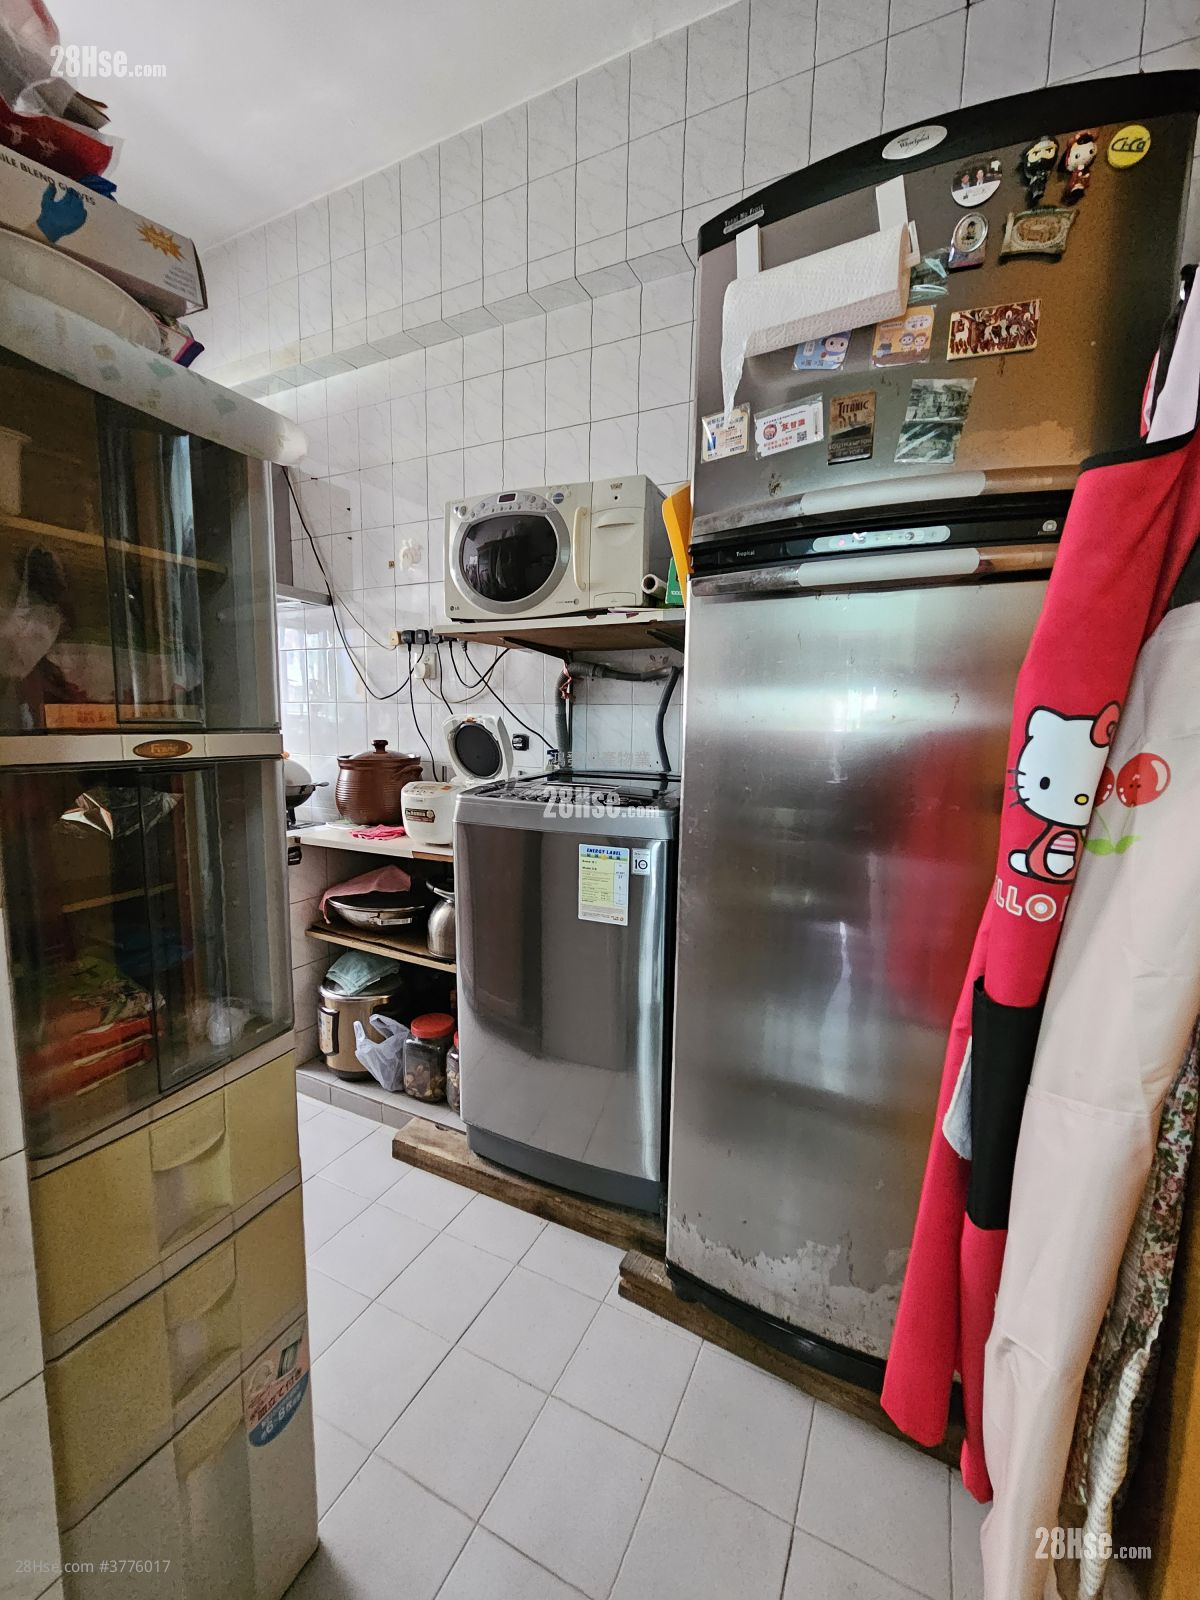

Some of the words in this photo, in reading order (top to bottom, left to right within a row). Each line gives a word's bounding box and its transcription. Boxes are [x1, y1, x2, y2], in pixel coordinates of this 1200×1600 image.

[0, 153, 18, 168] ILE
[20, 162, 55, 184] BLEND
[58, 182, 96, 205] GVES
[838, 400, 868, 415] TITANIC
[995, 874, 1057, 922] LLO
